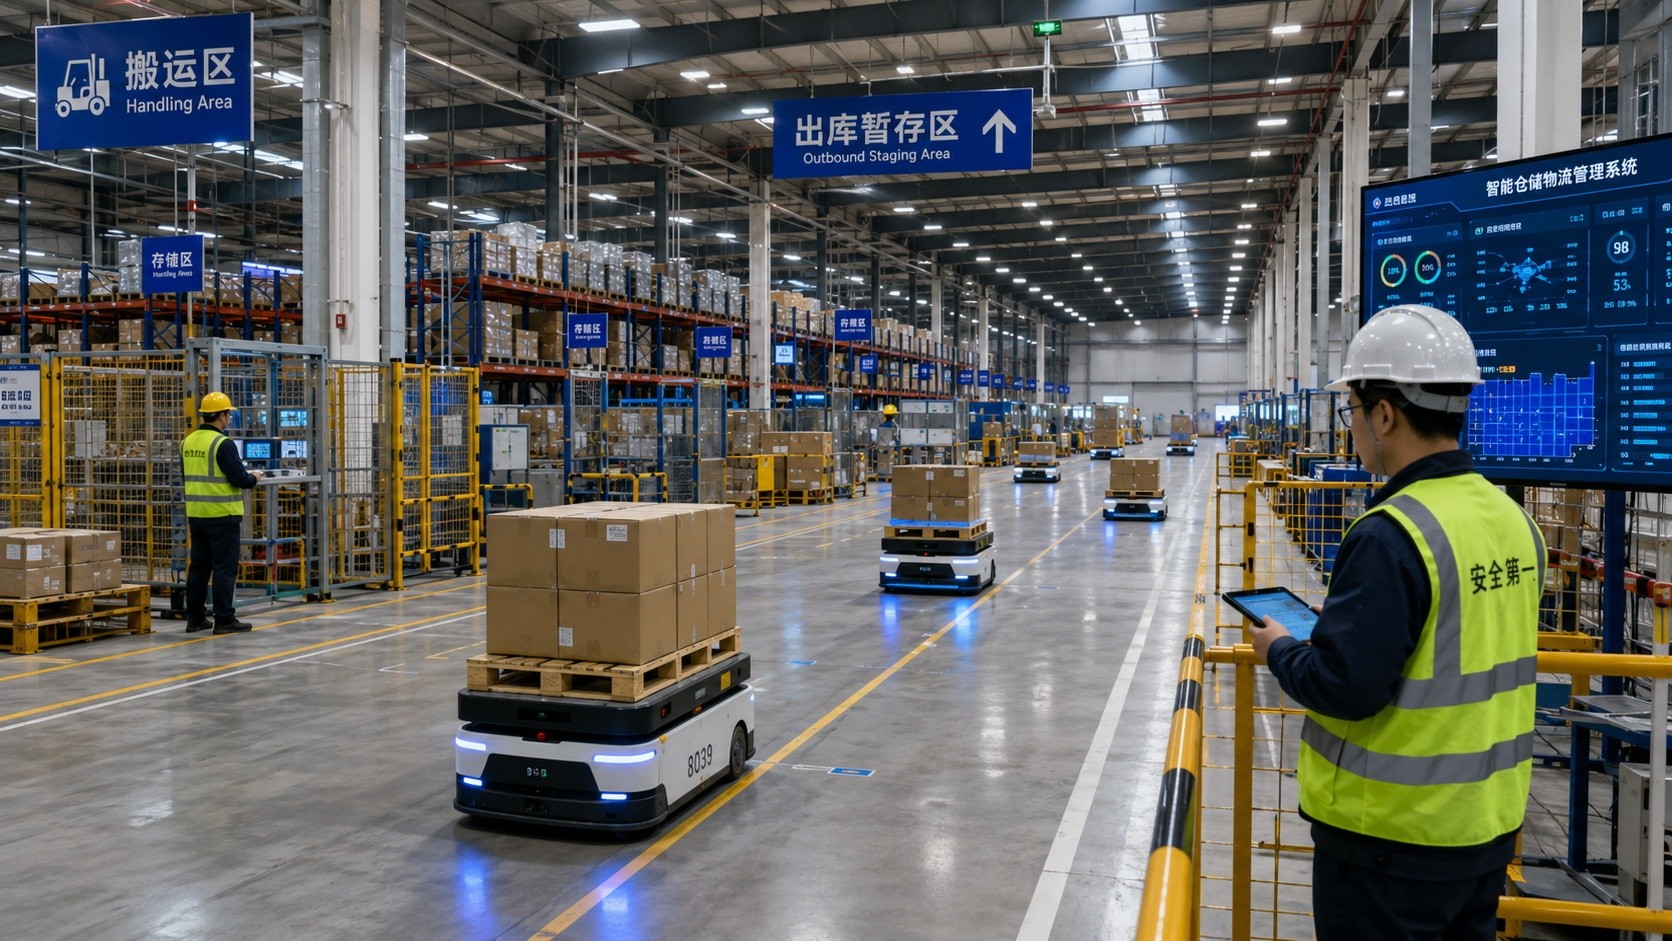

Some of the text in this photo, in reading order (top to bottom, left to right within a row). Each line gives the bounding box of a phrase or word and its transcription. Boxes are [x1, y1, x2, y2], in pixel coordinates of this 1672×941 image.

[125, 46, 236, 91] 搬运区
[126, 94, 233, 115] Handling Area
[795, 109, 959, 147] 出库暂存区
[803, 148, 951, 164] Outbound Staging Area
[1486, 157, 1638, 197] 智能仓储物流管理系统
[1470, 557, 1535, 595] 安全第一
[687, 743, 713, 778] 8039
